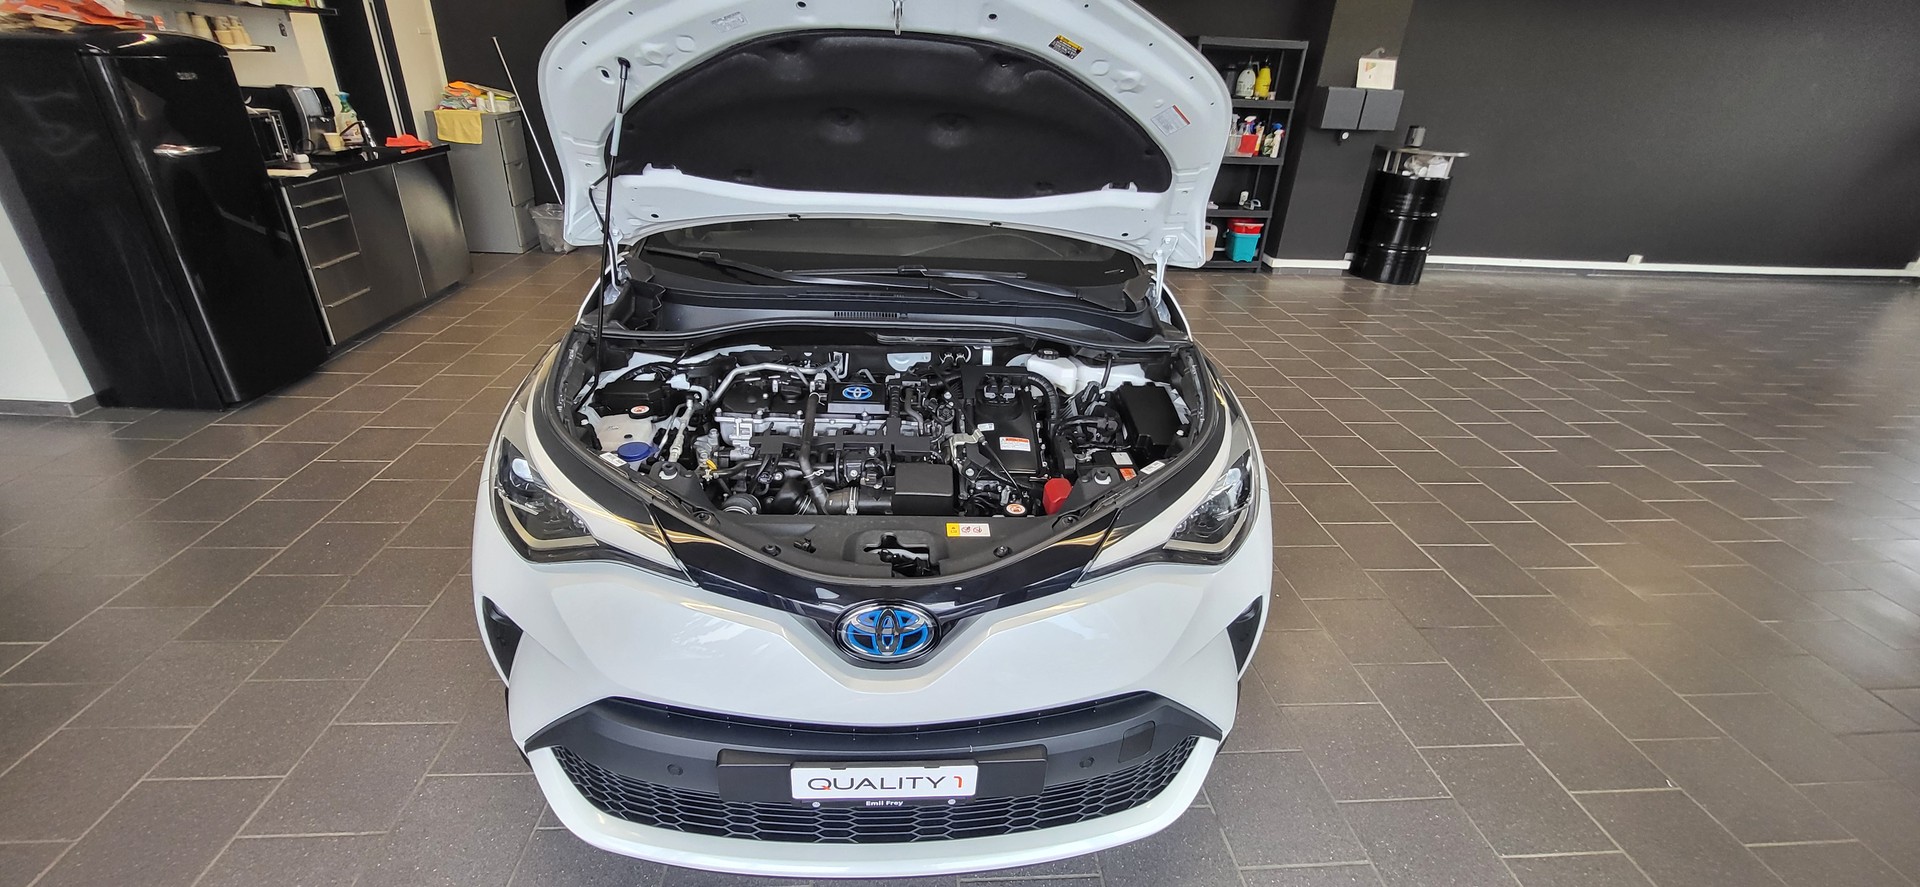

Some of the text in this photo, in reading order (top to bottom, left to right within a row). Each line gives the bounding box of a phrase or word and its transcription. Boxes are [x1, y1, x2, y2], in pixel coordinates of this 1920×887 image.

[807, 776, 963, 791] QUALITY 1
[885, 799, 904, 807] Frey
